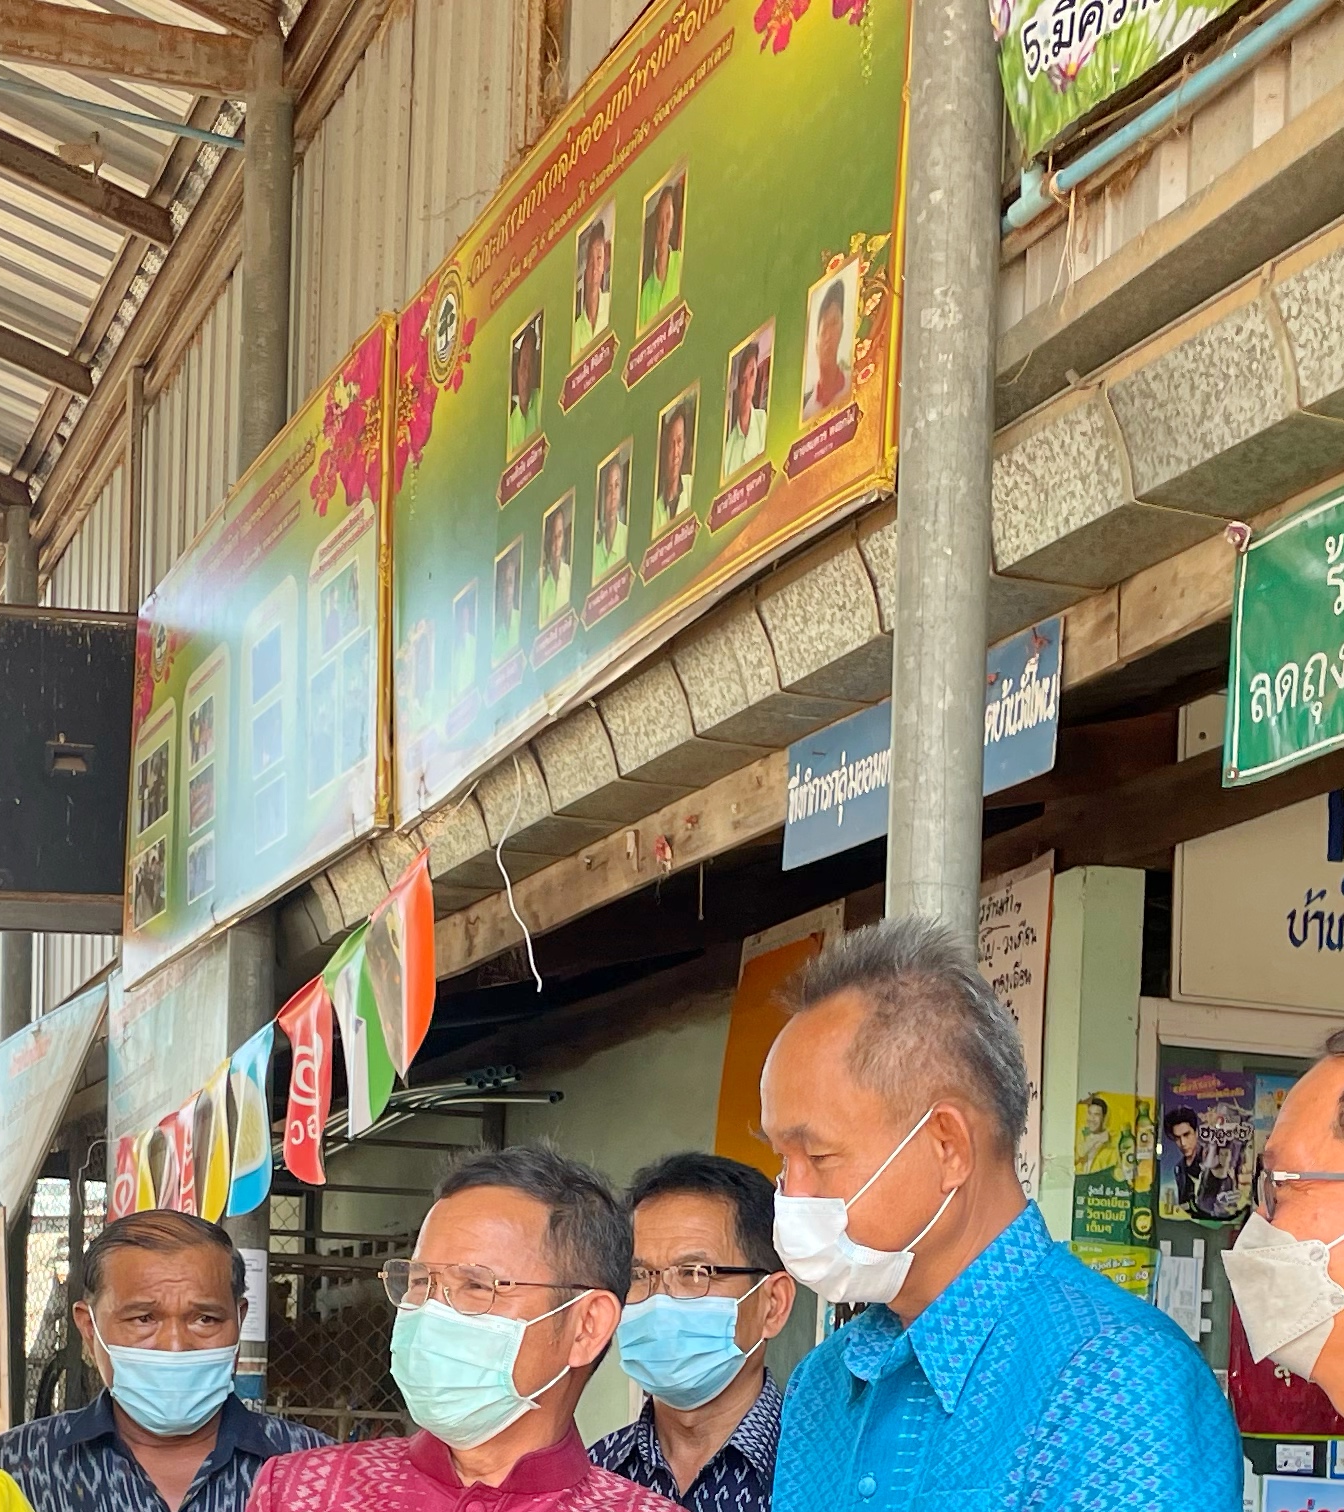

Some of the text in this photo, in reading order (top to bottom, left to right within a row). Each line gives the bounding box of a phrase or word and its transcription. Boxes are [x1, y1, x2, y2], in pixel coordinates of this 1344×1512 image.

[470, 0, 723, 286] คณะกรรมการกลุ่มออมทรัพย์เพื่อก
